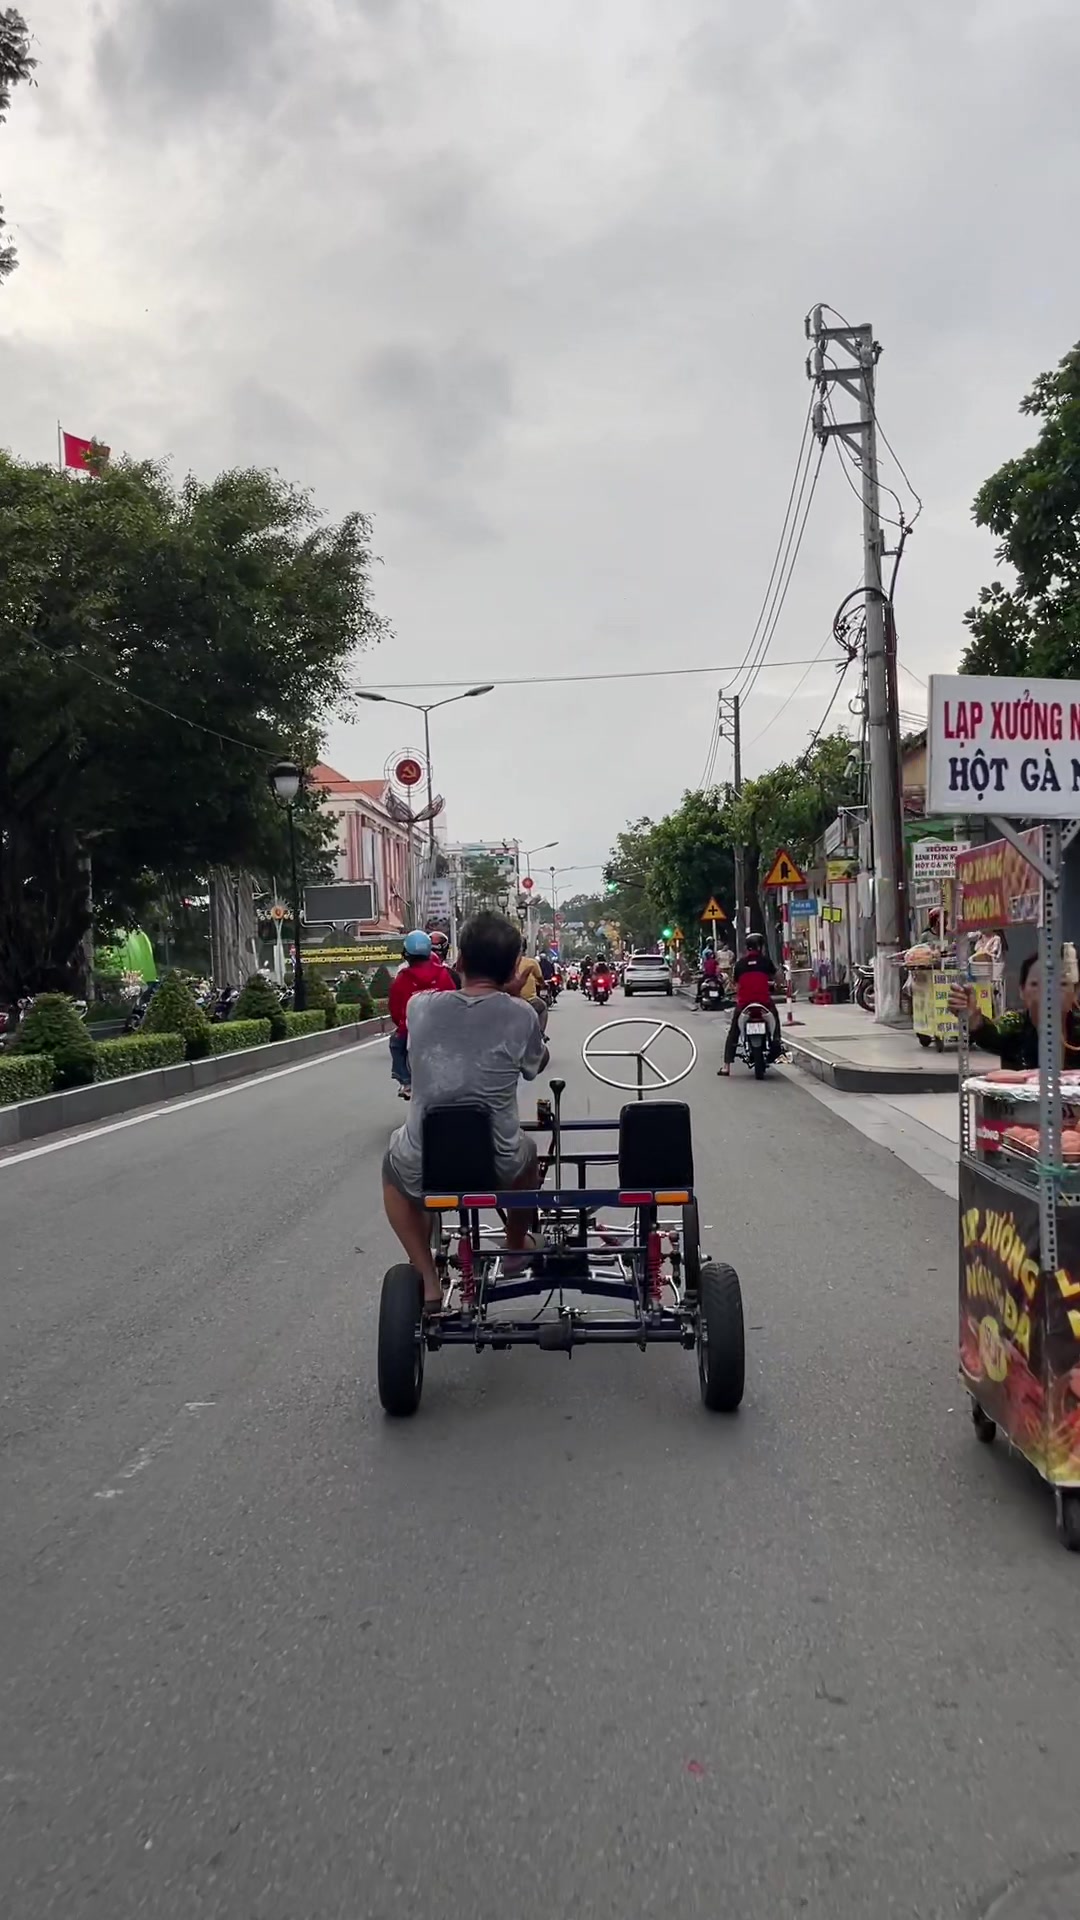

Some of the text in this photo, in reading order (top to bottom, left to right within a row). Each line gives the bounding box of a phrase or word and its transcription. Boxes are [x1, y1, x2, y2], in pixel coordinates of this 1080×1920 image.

[944, 700, 983, 748] LẠP
[991, 689, 1063, 741] XƯỞNG
[948, 748, 1009, 801] HỘT
[1020, 748, 1061, 792] GÀ
